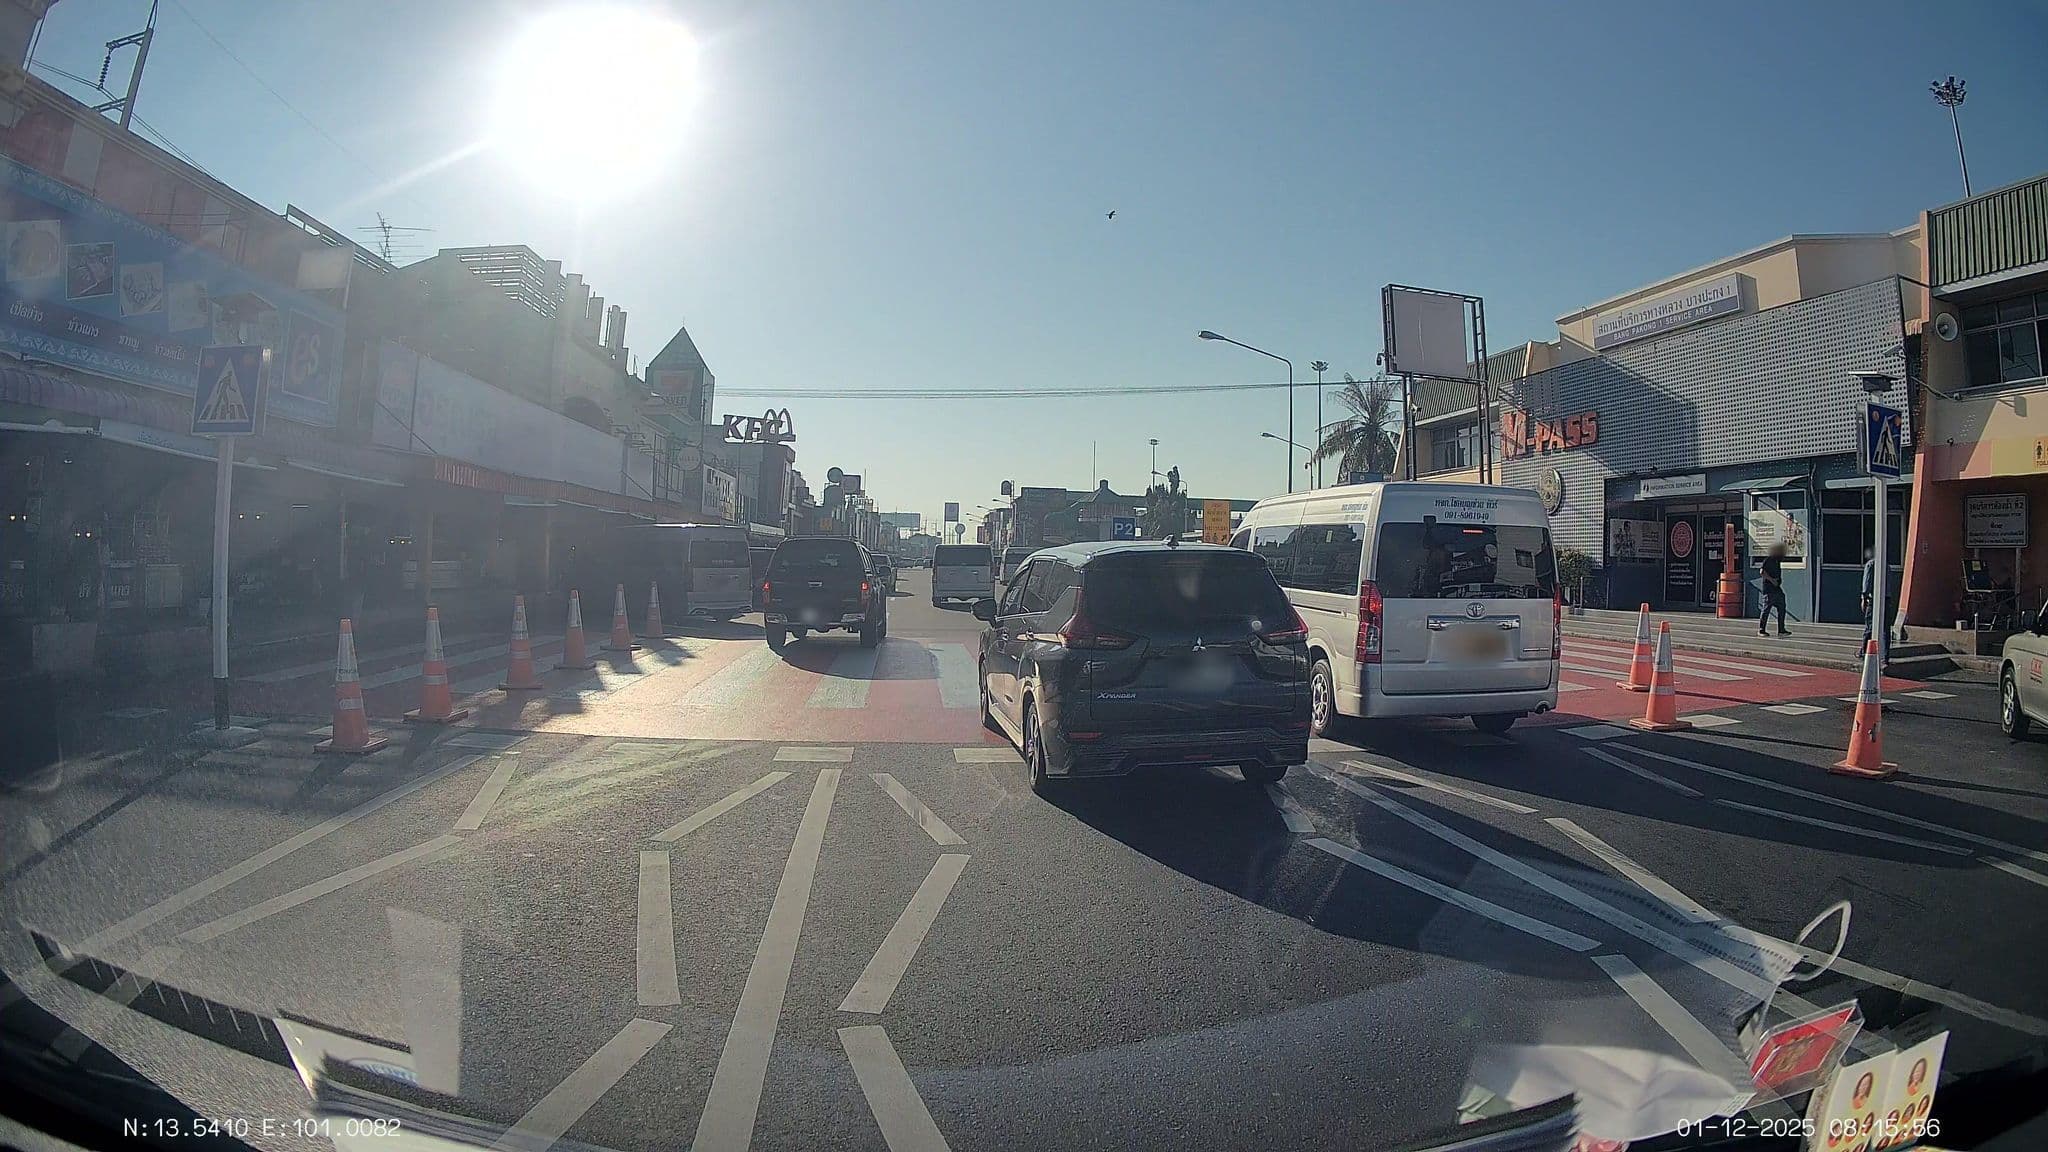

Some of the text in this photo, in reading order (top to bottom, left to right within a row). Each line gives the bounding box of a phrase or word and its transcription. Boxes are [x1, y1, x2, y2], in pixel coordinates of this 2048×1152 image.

[1598, 285, 1731, 334] สถานที่บริการทางหลวง บางปะกง 1
[1613, 331, 1630, 341] BANG
[1631, 323, 1657, 335] PAKONG
[1665, 312, 1693, 325] SERVICE
[1695, 305, 1713, 317] AREA
[1501, 409, 1597, 459] M-PASS
[1114, 522, 1134, 536] P2
